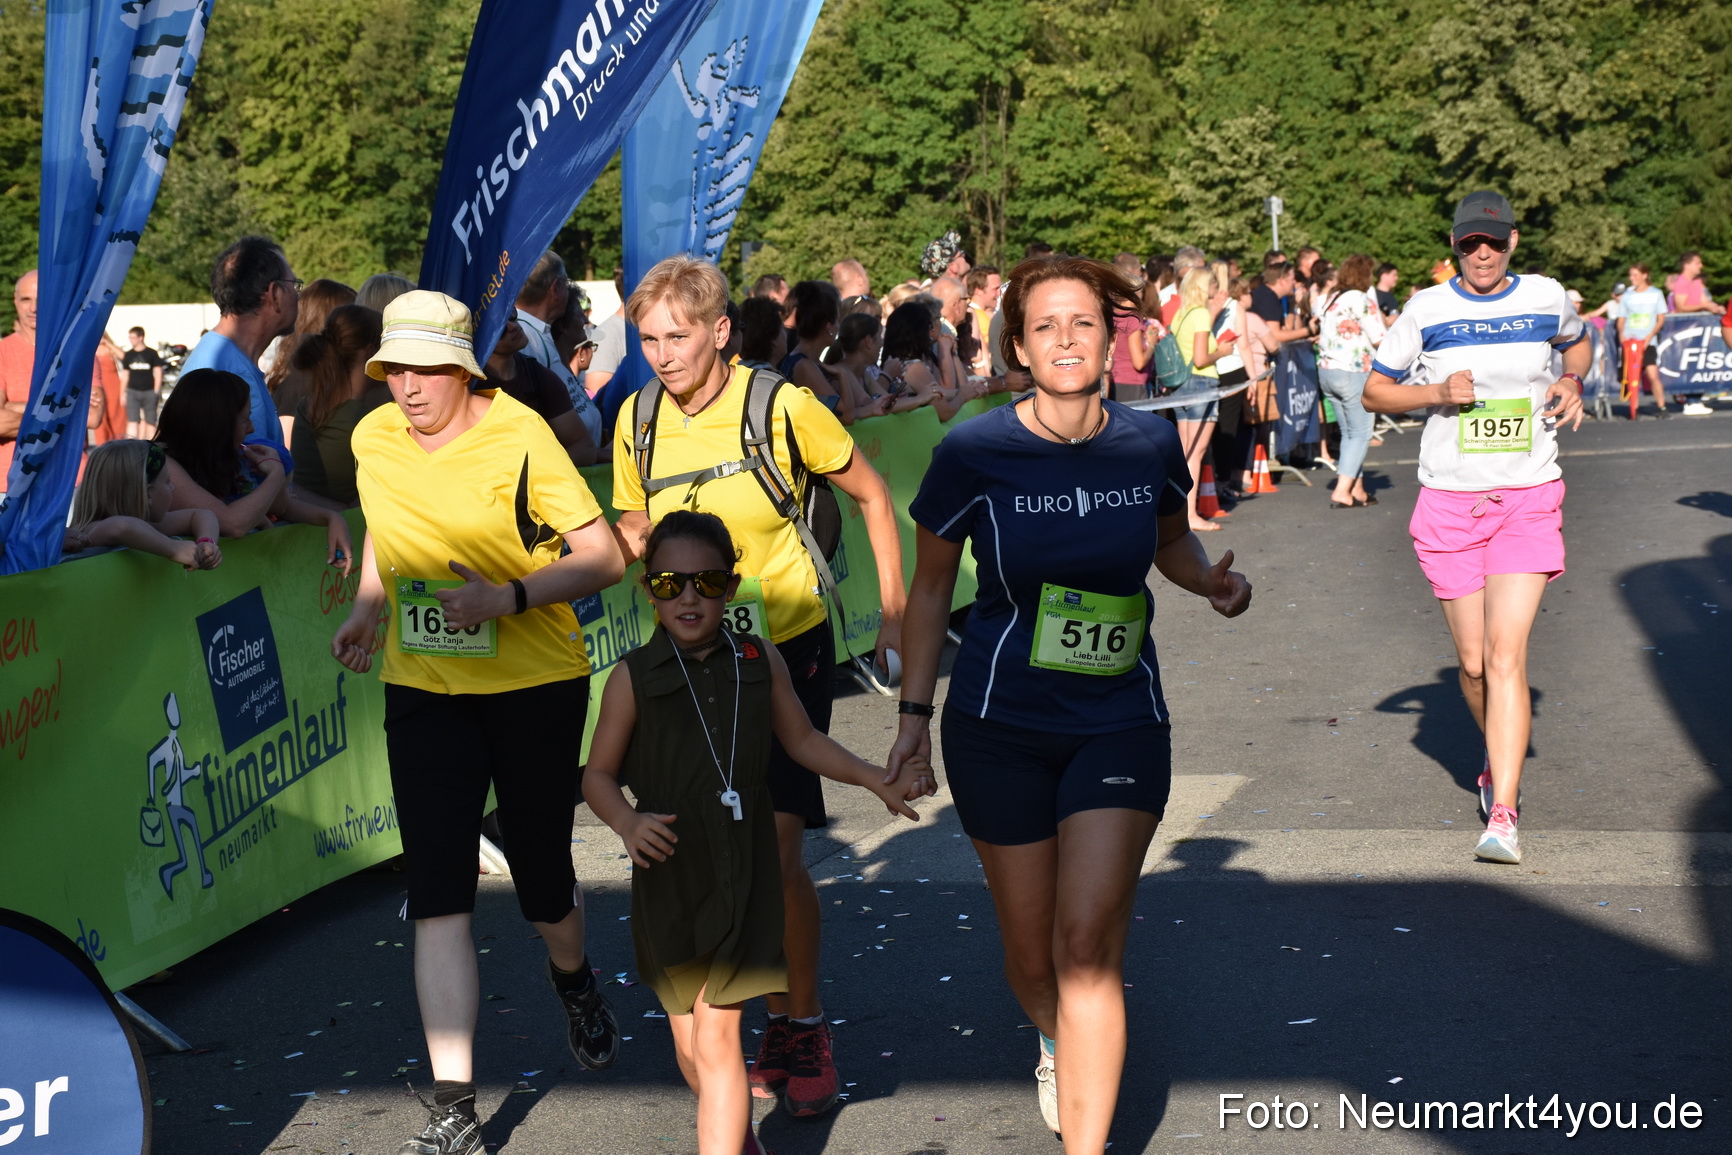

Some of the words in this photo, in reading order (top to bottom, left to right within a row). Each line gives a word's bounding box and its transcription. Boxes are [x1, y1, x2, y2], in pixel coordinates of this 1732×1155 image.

[573, 43, 625, 121] Druck
[451, 0, 632, 265] Frischman
[1475, 319, 1534, 333] PLAST
[1470, 417, 1524, 437] 1957
[1053, 599, 1097, 613] firmenlauf
[423, 635, 441, 643] Götz
[442, 636, 464, 646] Tanja
[437, 643, 458, 651] Stiftung
[1060, 619, 1127, 653] 516
[219, 637, 265, 676] Fischer
[1065, 658, 1095, 667] Europoles
[1073, 651, 1093, 660] Lieb
[1095, 653, 1111, 662] Lilli
[228, 660, 266, 689] AUTOMOBILE
[202, 671, 348, 848] firmenlauf
[219, 803, 278, 872] neumarkt
